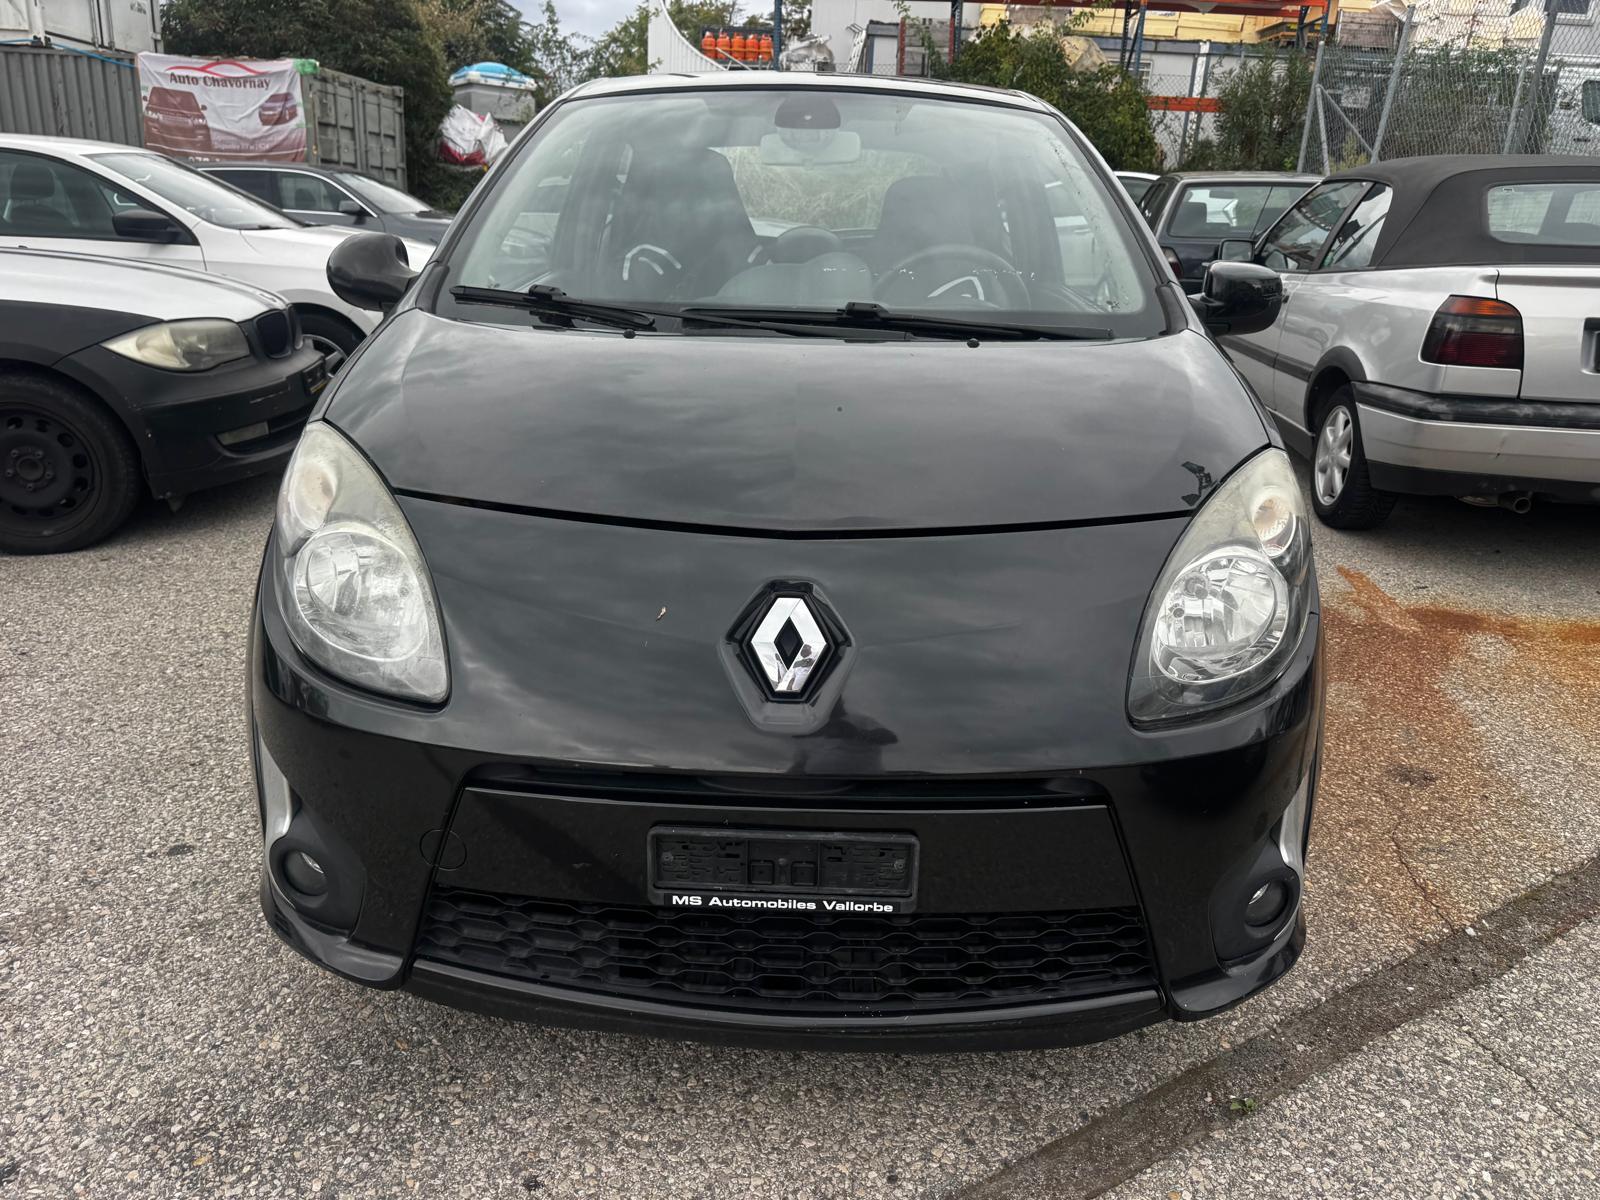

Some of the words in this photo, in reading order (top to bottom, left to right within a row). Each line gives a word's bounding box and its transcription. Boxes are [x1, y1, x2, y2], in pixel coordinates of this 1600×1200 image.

[169, 72, 199, 86] Auto
[202, 75, 271, 91] Chavornay
[672, 895, 703, 906] MS
[708, 896, 817, 910] Automobiles
[822, 900, 894, 913] Vallorbe
